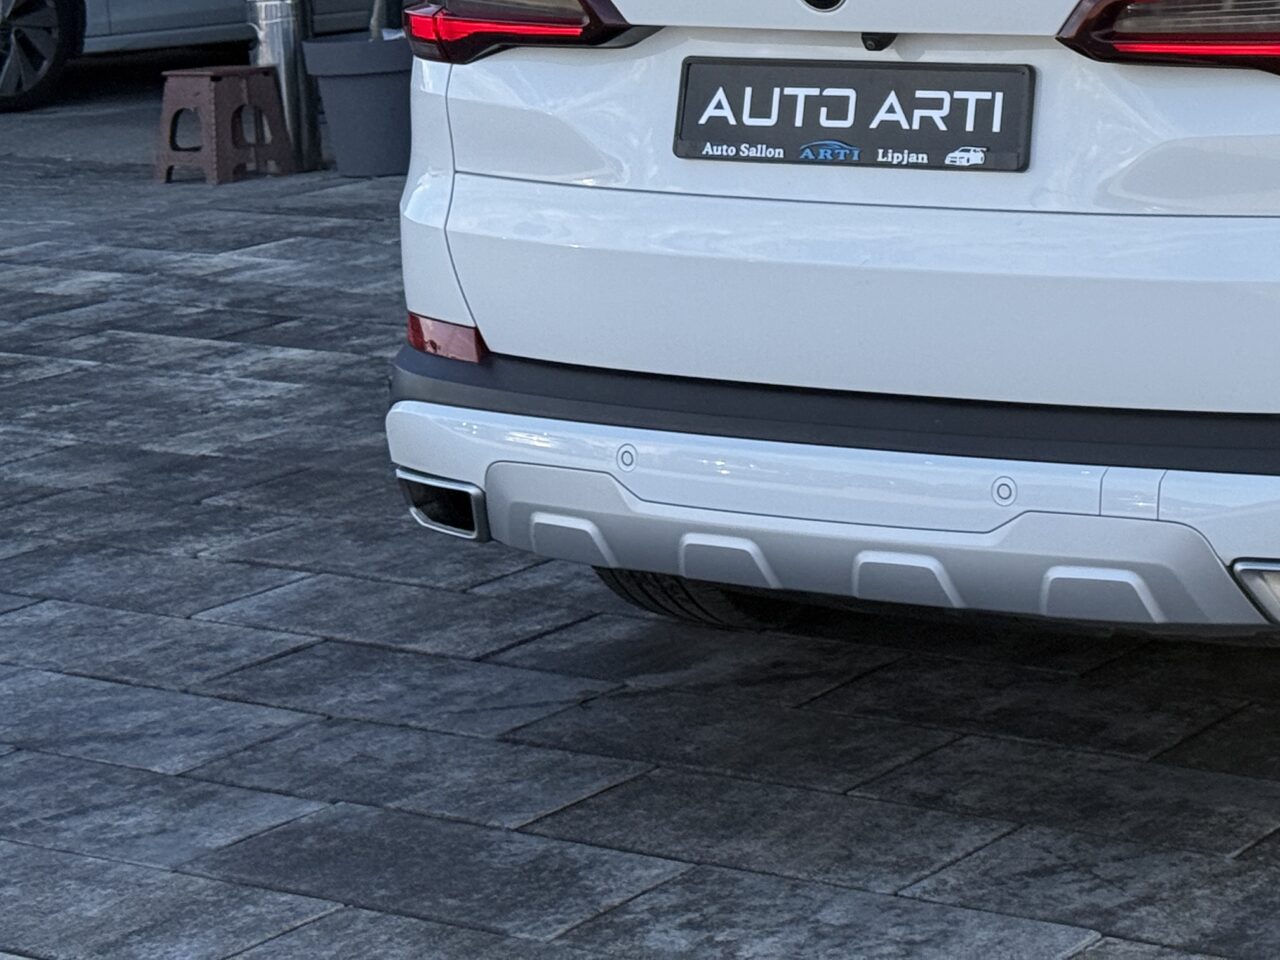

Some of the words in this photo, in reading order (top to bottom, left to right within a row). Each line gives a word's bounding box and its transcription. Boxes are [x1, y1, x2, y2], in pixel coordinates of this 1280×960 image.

[698, 86, 857, 128] AUTO
[869, 90, 1004, 133] ARTI
[702, 142, 737, 157] Auto
[740, 143, 784, 159] Sallon
[799, 146, 860, 162] ARTI
[876, 148, 928, 165] Lipjan
